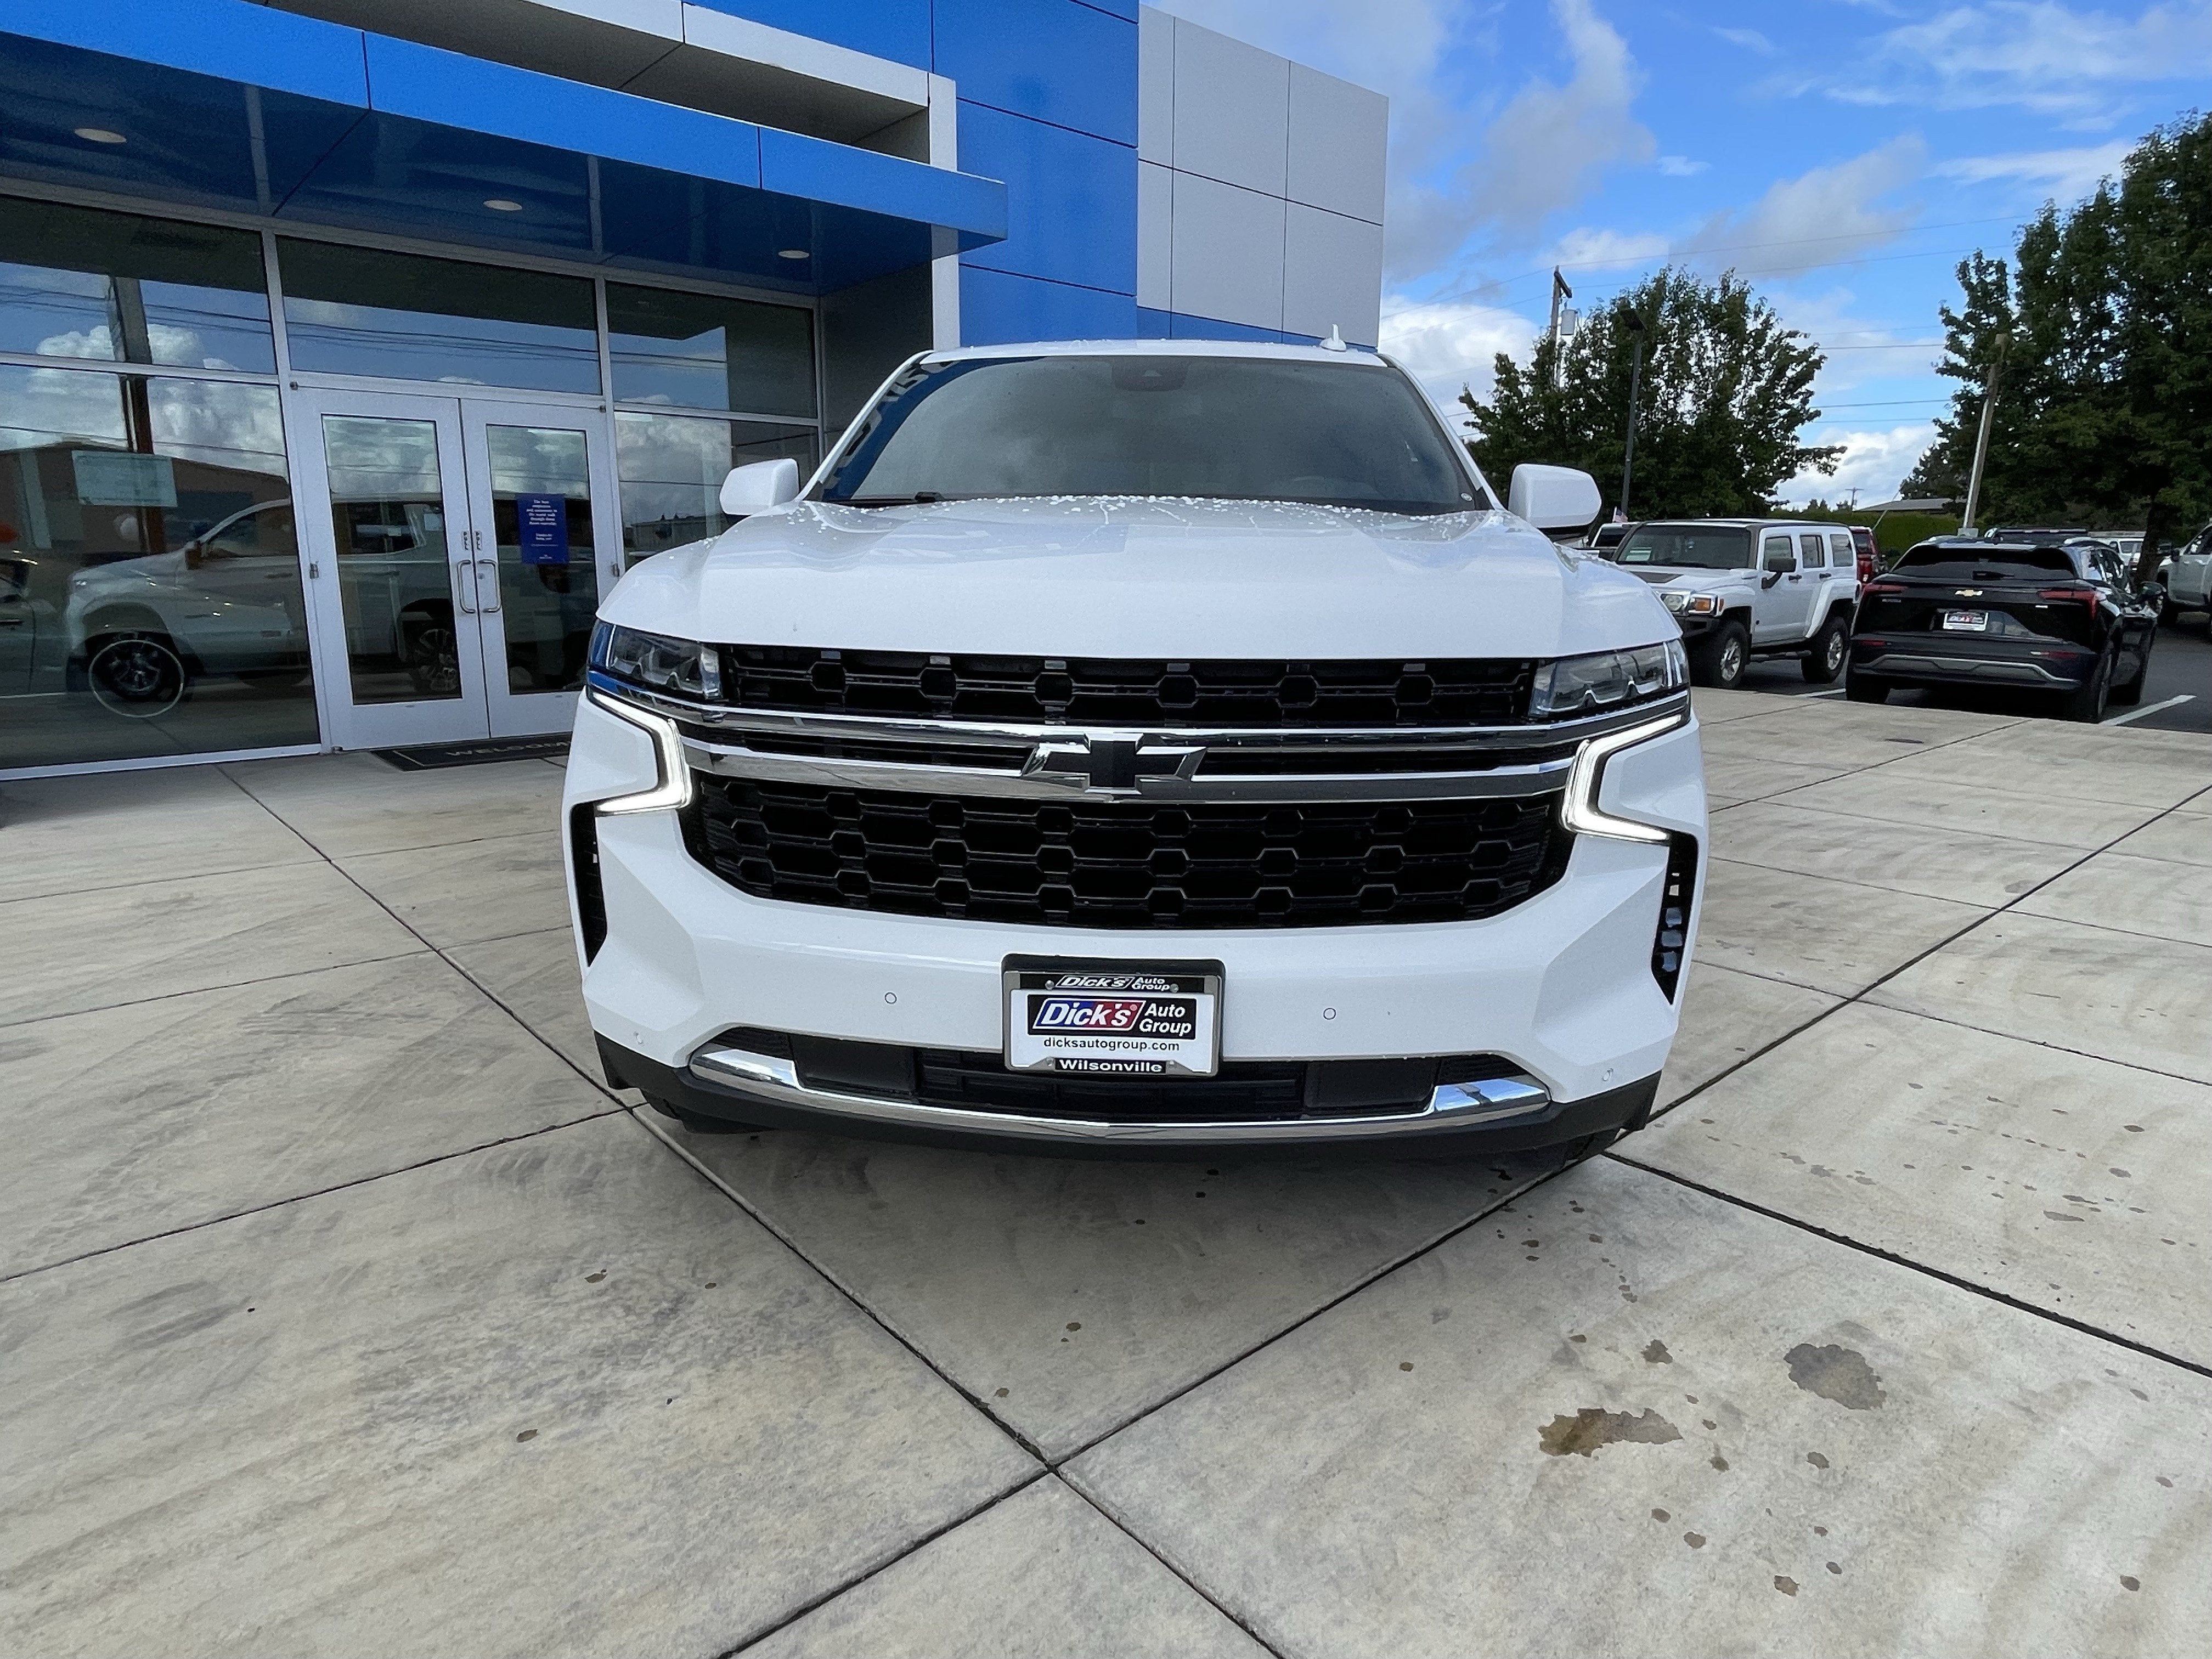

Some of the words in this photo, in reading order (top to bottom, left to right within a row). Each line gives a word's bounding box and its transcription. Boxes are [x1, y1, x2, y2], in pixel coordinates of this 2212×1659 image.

[1060, 977, 1128, 988] Dick's
[1133, 977, 1165, 985] Auto
[1041, 1002, 1131, 1026] Dick's
[1145, 1003, 1186, 1018] Auto
[1139, 1019, 1192, 1036] Group
[1043, 1037, 1180, 1052] dicksautogroup.com
[1059, 1058, 1163, 1073] Wilsonville
